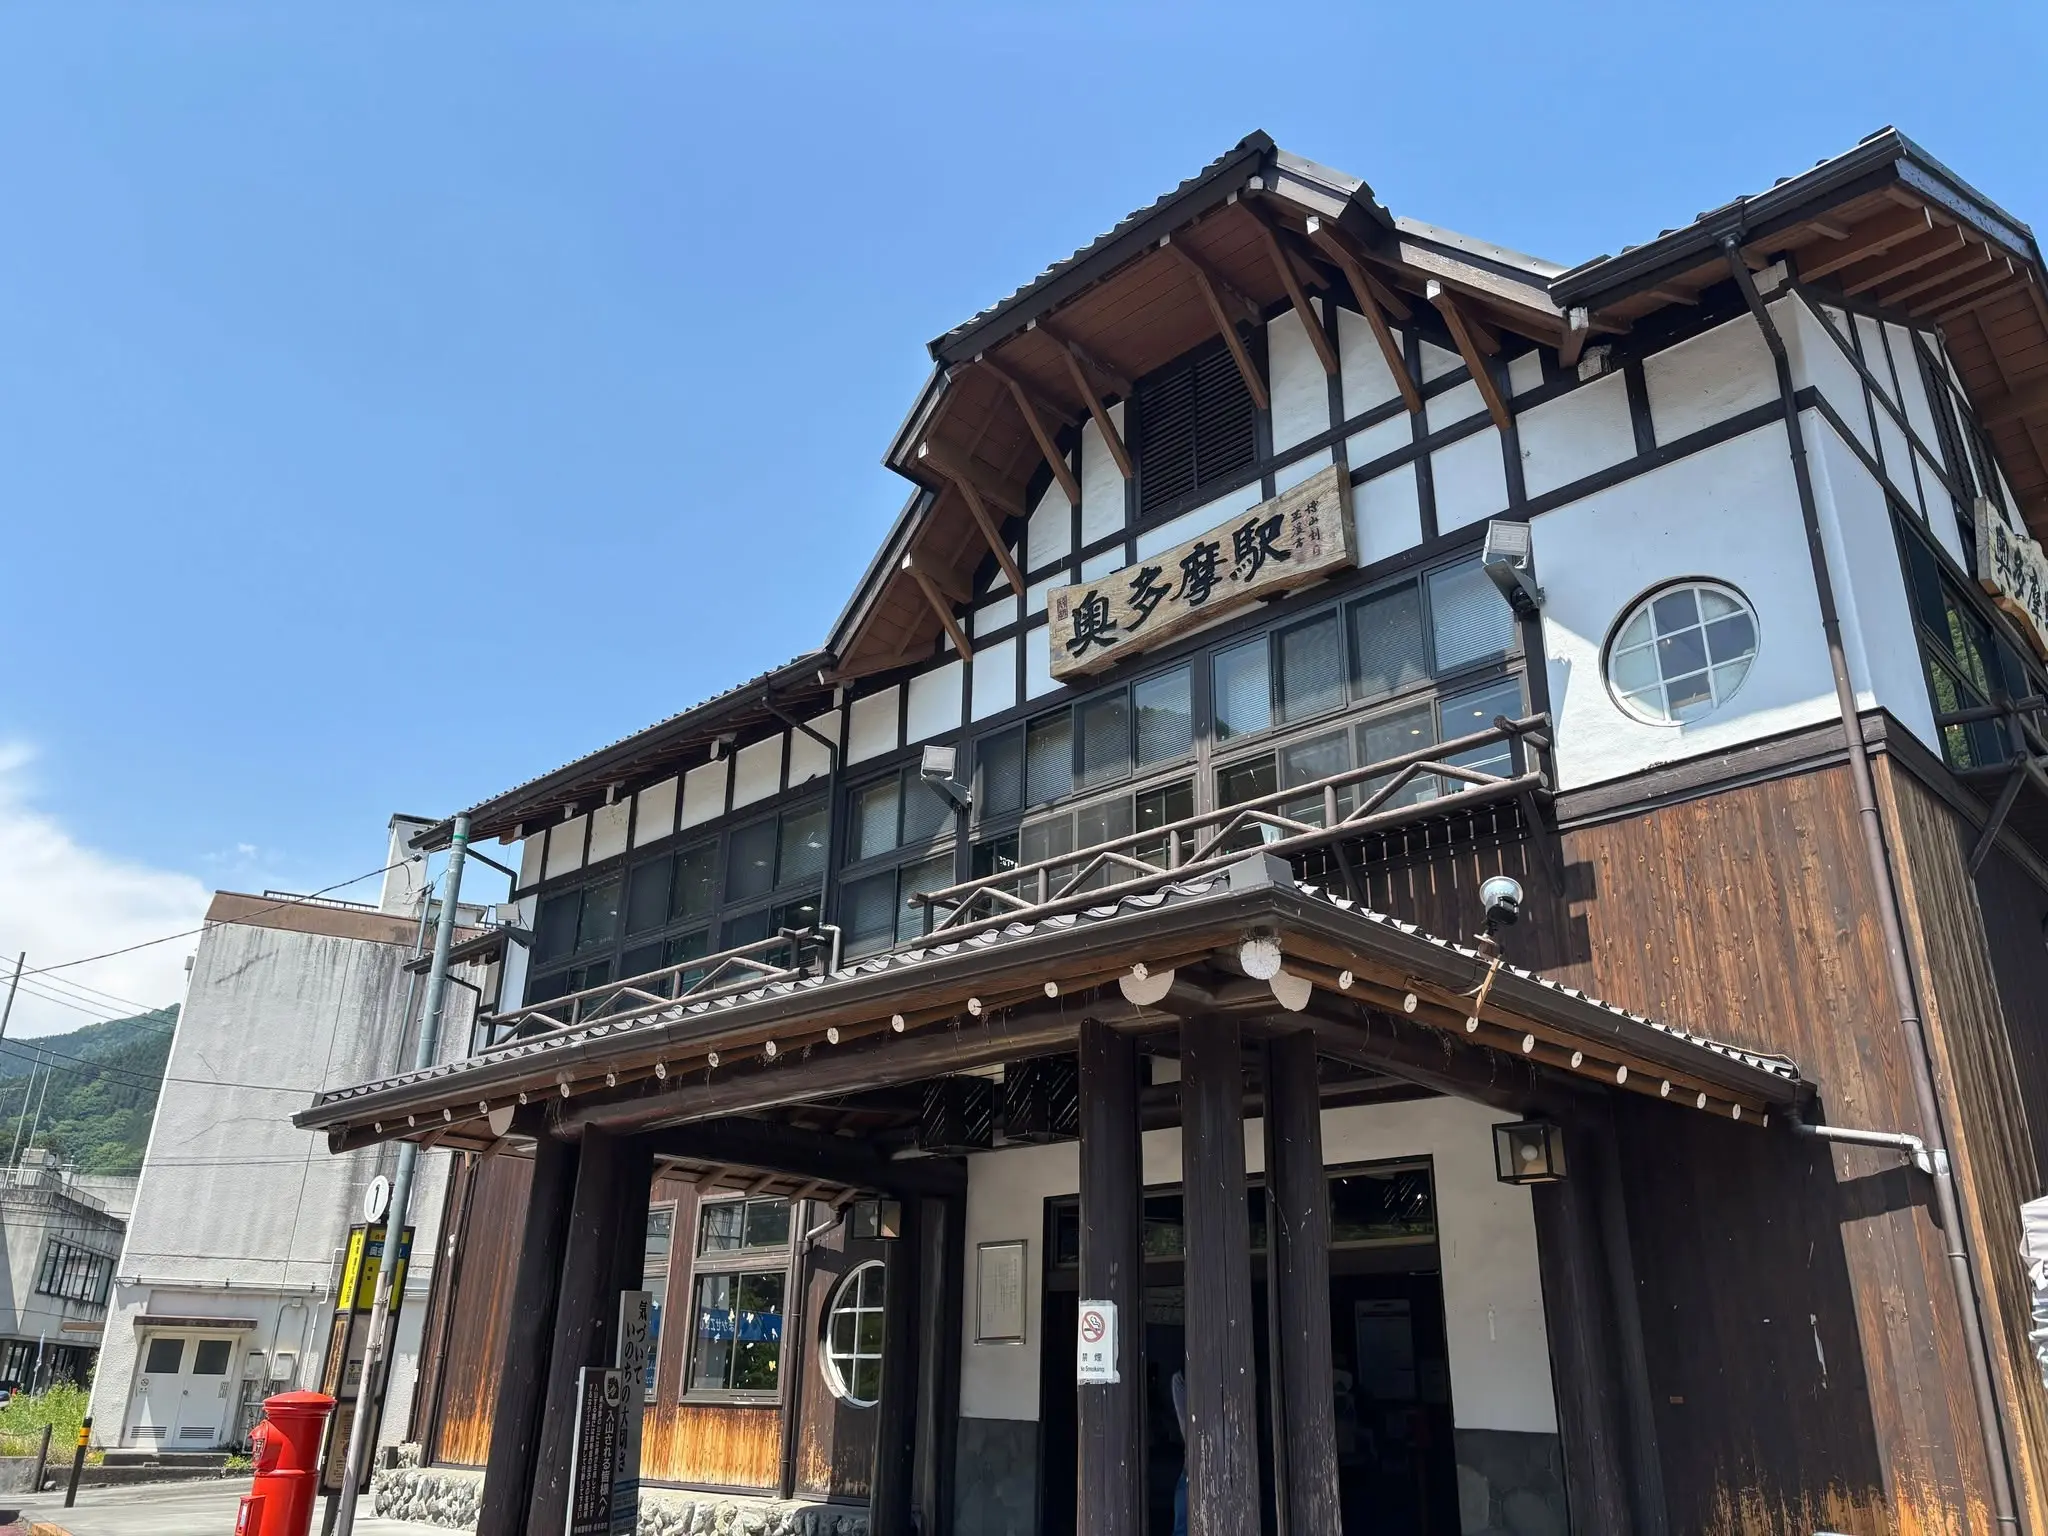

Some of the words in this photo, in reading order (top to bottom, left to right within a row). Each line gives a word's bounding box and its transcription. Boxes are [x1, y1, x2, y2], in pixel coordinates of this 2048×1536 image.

[1066, 514, 1291, 658] 奥多摩駅
[1995, 523, 2048, 632] 奥多摩
[372, 1184, 380, 1214] 1
[618, 1322, 635, 1472] いのちの大切さ
[633, 1300, 648, 1385] 気づいて
